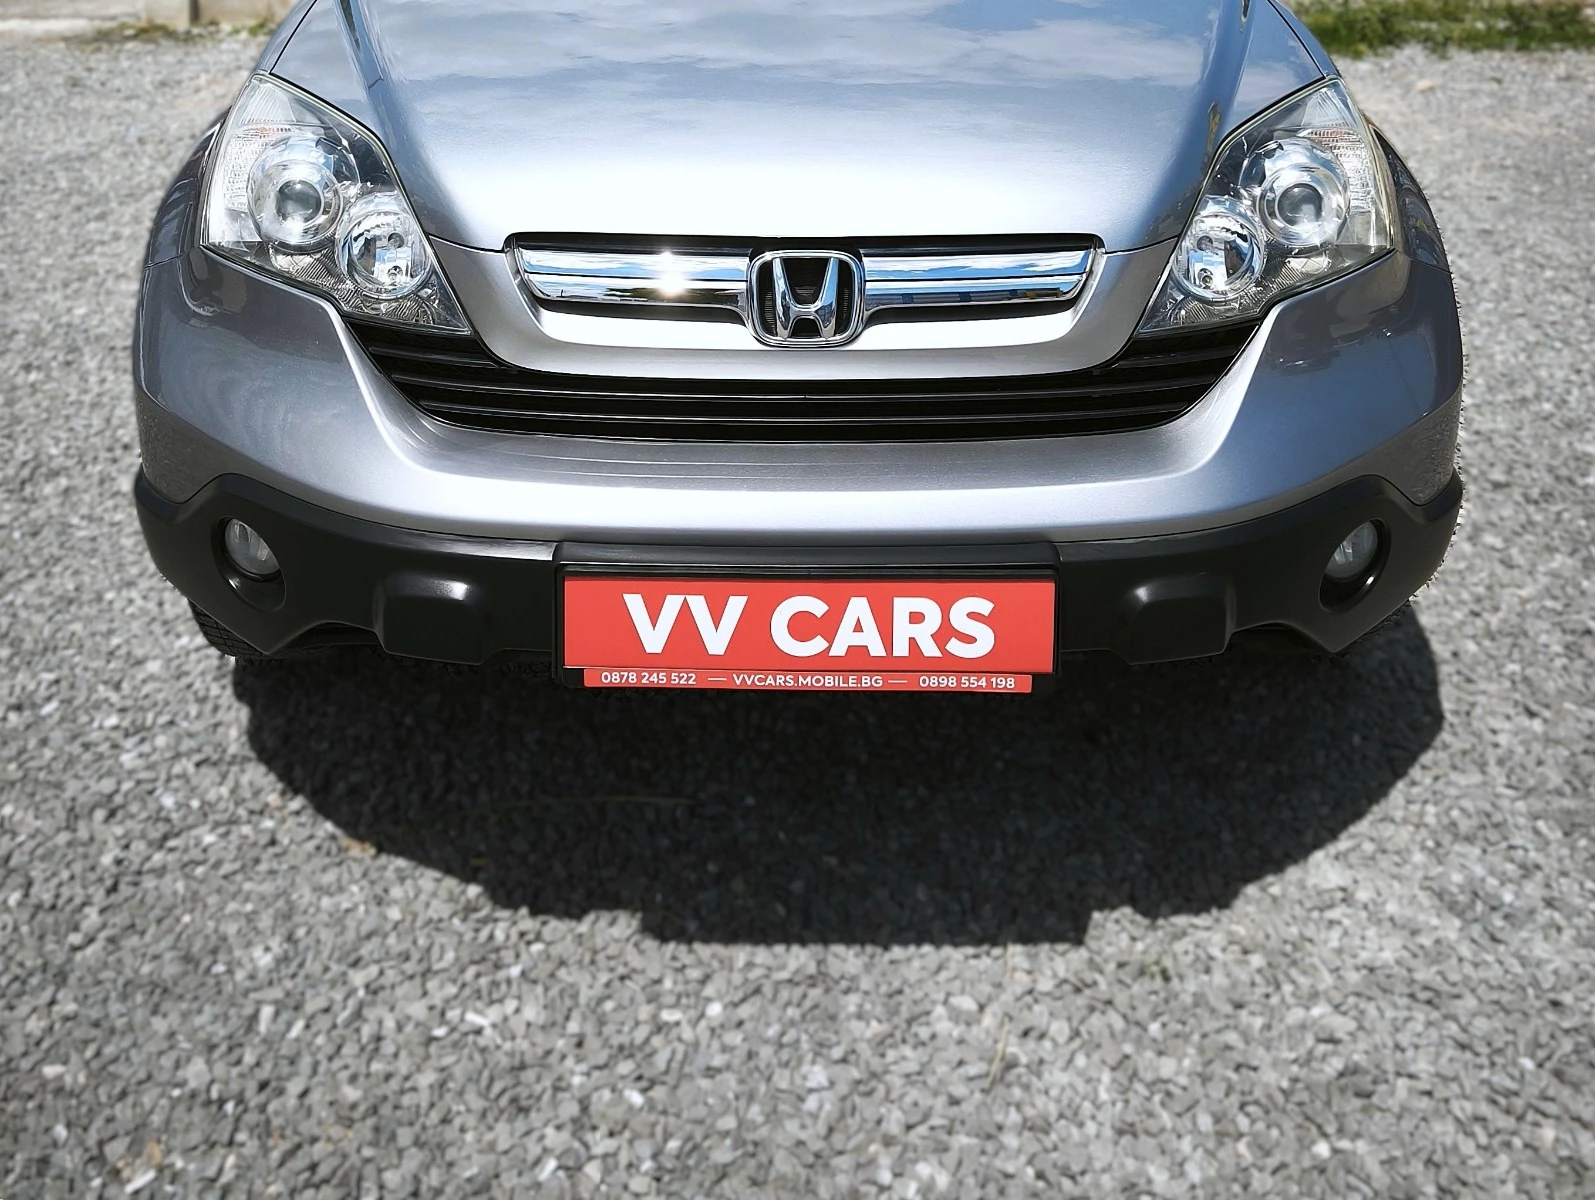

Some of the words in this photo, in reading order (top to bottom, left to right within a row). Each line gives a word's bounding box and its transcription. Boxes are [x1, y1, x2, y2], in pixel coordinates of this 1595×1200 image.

[622, 593, 748, 656] VV
[770, 595, 996, 659] CARS
[601, 671, 637, 684] 0878
[641, 672, 667, 685] 245
[670, 673, 696, 685] 522
[733, 673, 883, 688] VVCARS.MOBILE.BG
[919, 675, 957, 688] 0898
[961, 676, 987, 689] 554
[990, 677, 1015, 689] 198
